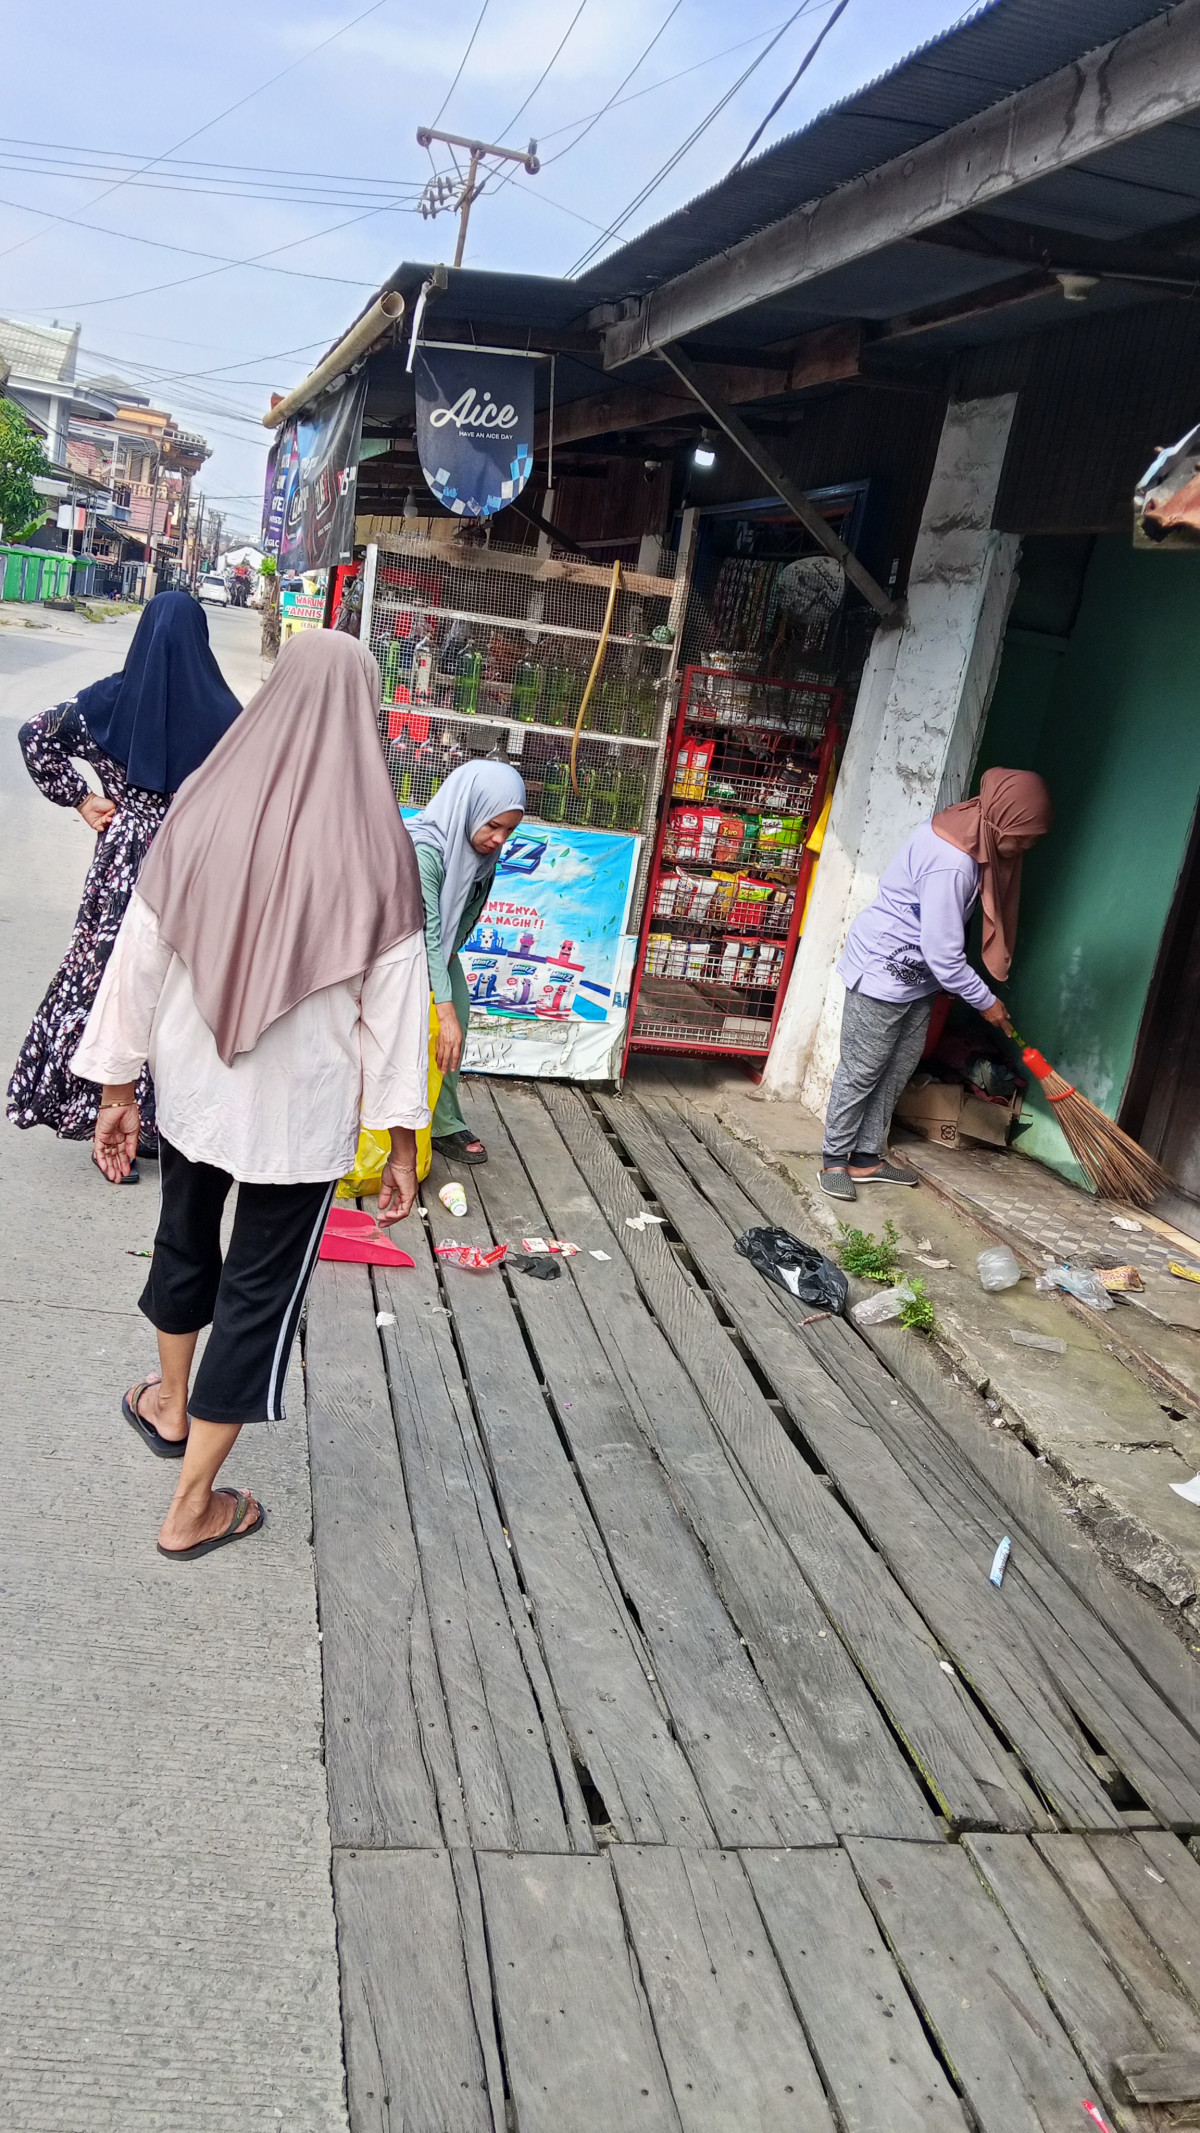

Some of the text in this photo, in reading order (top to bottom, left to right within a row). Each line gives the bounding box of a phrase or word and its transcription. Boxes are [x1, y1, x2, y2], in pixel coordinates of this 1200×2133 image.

[430, 388, 518, 428] Aice
[483, 900, 538, 916] INTZNYA
[495, 916, 531, 928] NAGIH
